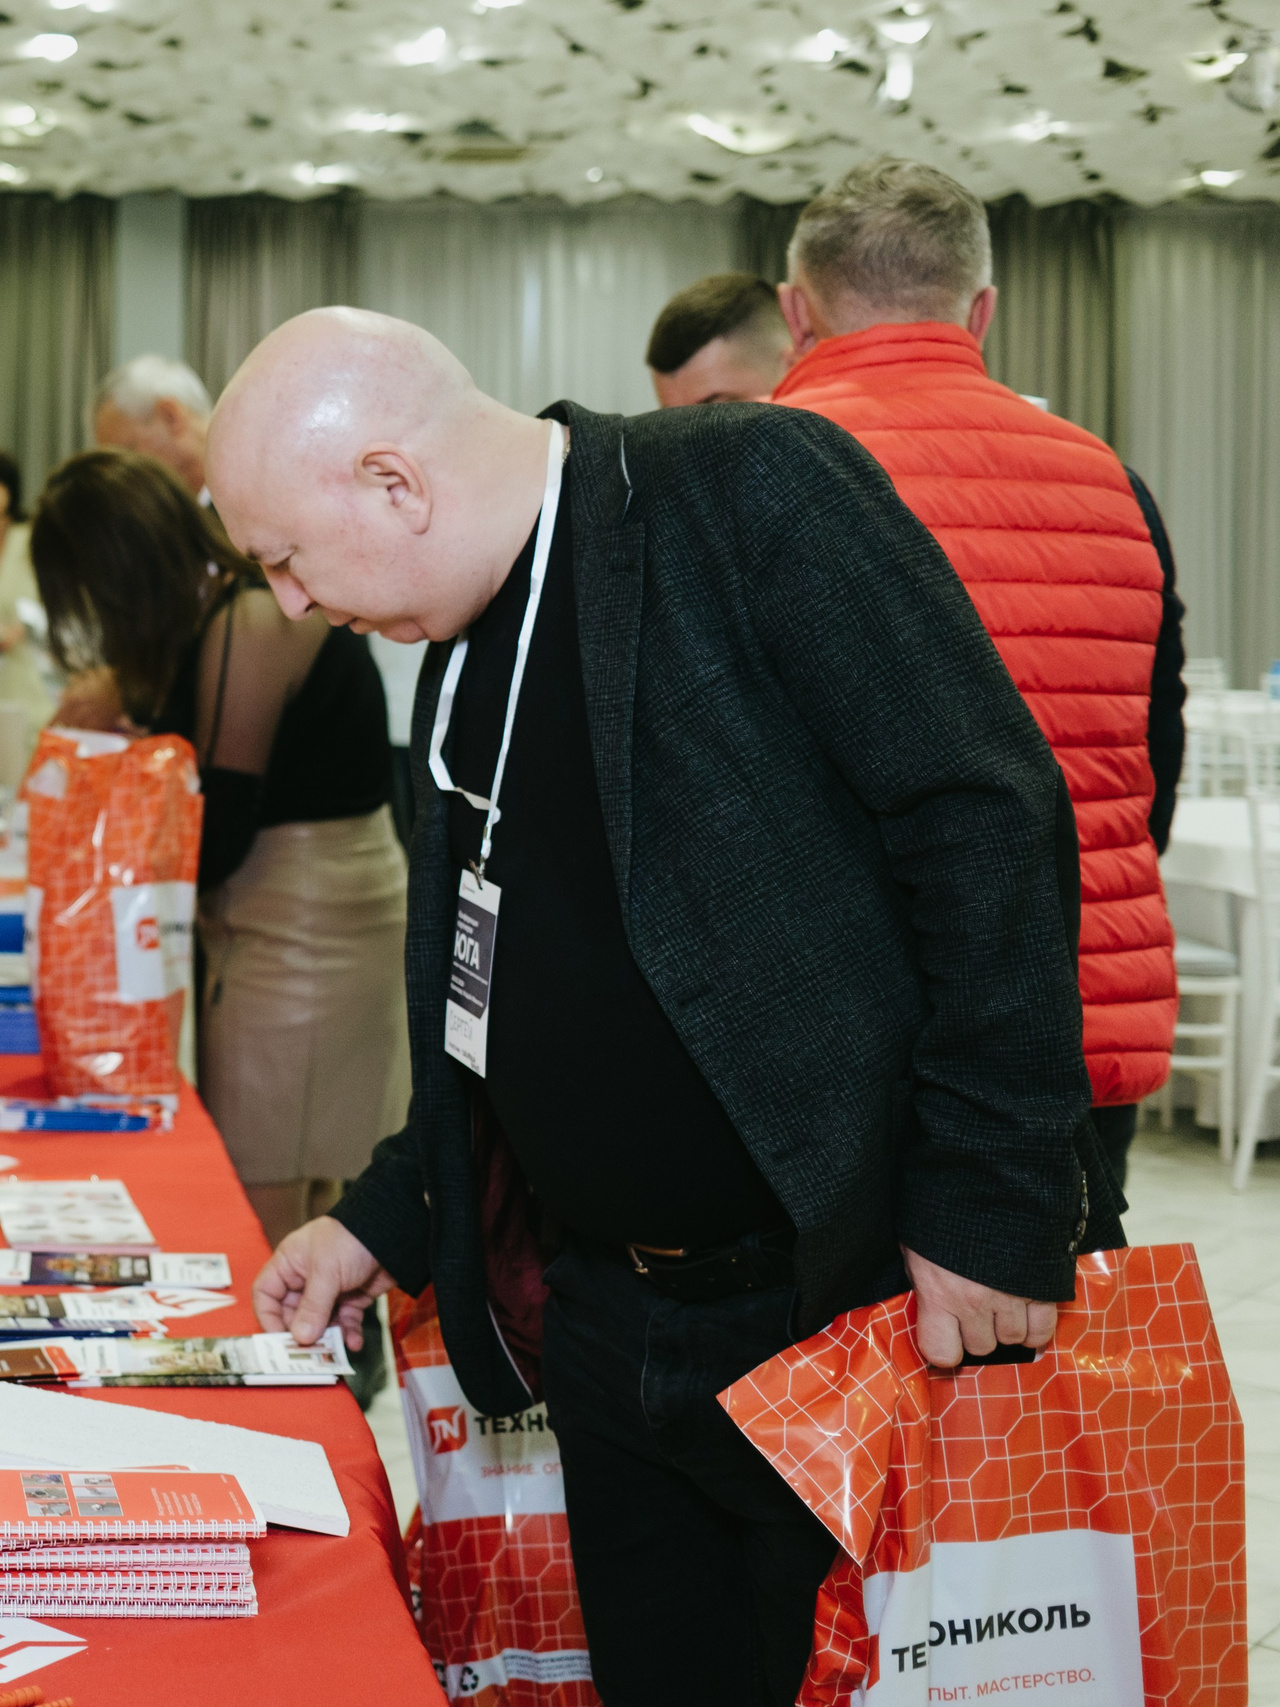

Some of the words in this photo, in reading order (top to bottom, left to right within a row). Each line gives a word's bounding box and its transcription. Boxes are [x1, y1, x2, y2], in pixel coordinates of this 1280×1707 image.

[453, 930, 480, 970] ЮГА
[891, 1603, 1091, 1673] ТЕОНИКОЛЬ
[928, 1686, 972, 1701] ПЫТ.
[976, 1668, 1096, 1698] МАСТЕРСТВО.
